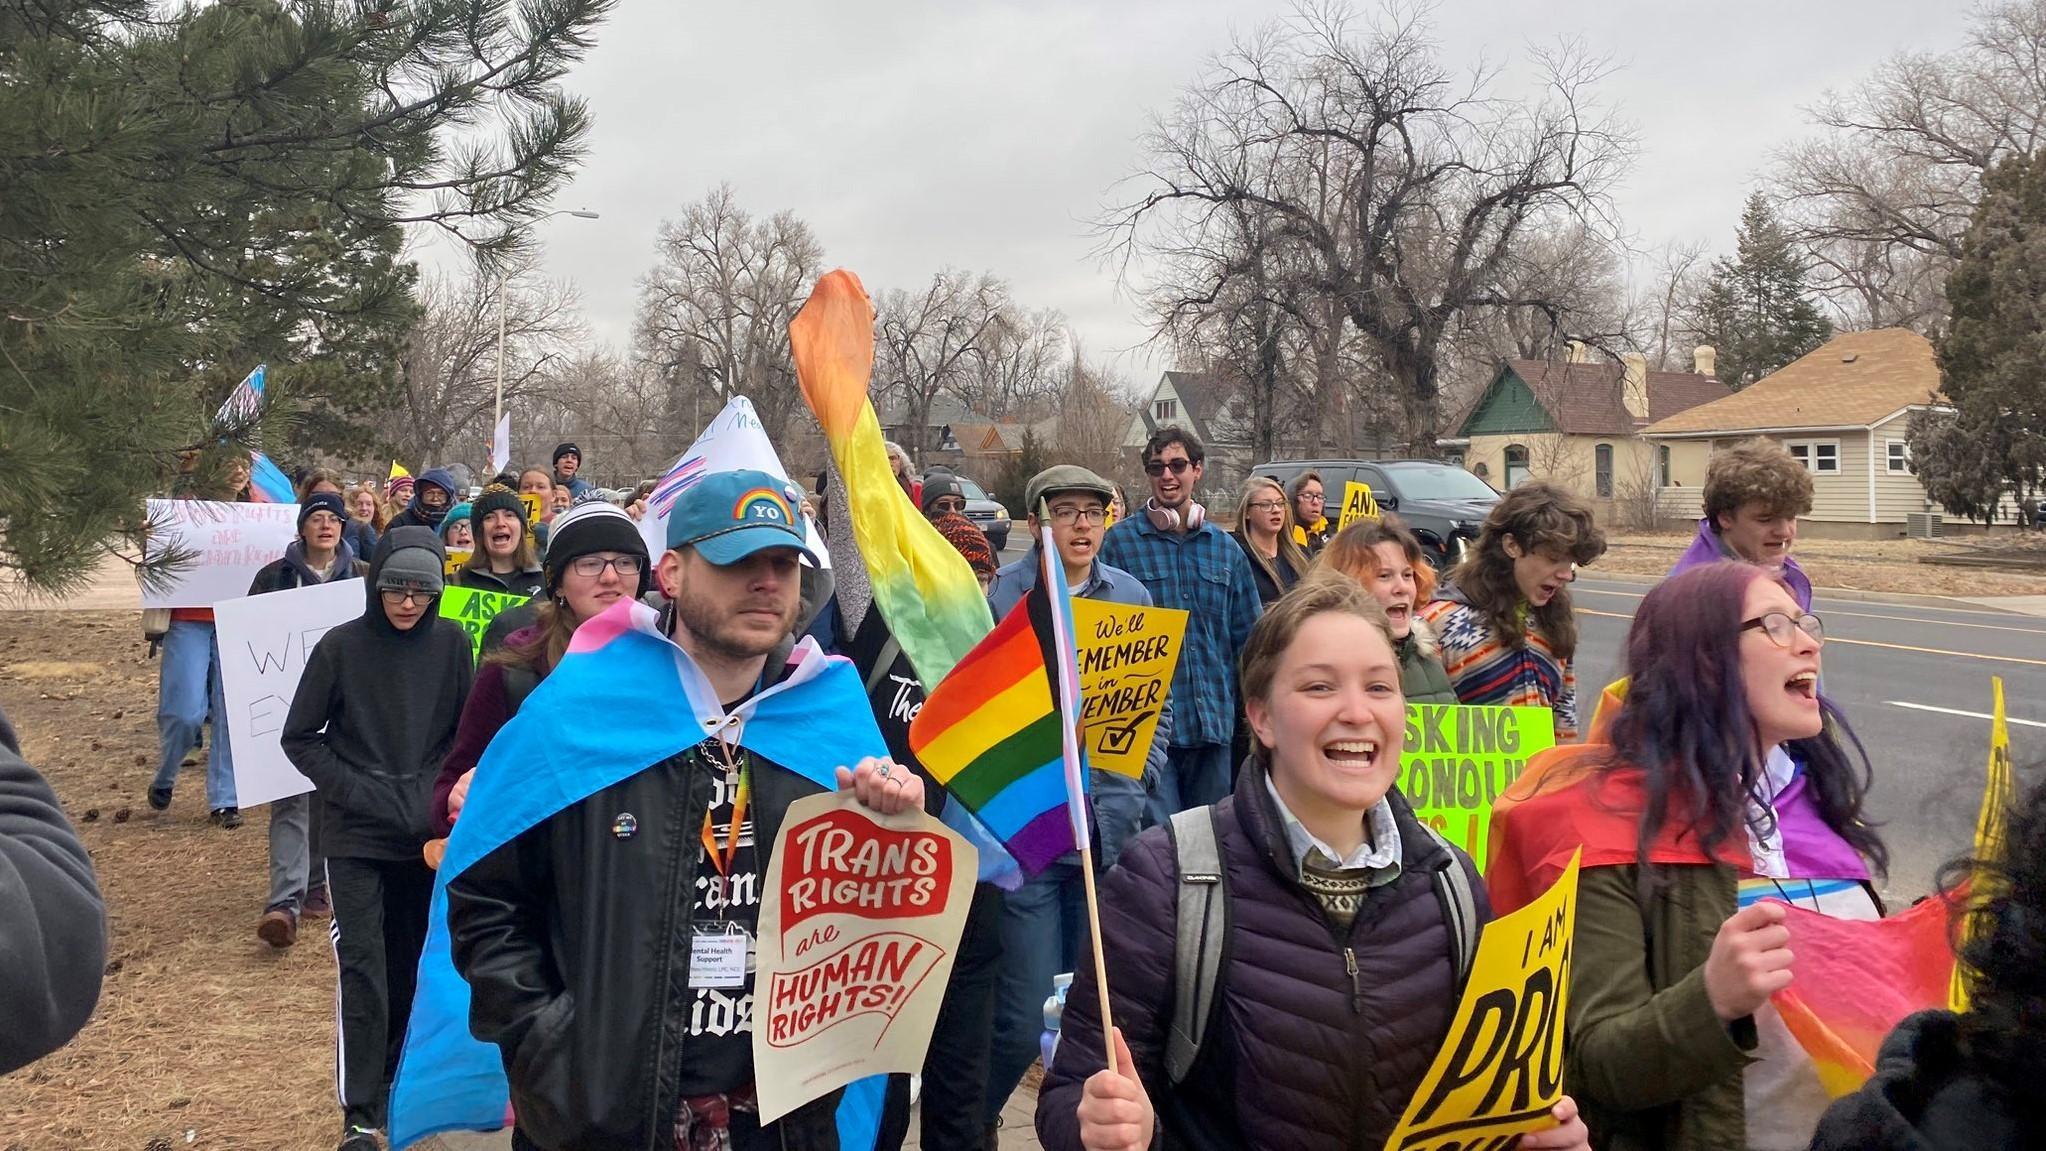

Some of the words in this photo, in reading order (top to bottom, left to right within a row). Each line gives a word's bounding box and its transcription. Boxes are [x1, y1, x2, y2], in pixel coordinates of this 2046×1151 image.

[752, 505, 779, 520] YO
[1095, 612, 1145, 639] We'll
[1098, 676, 1118, 690] in
[250, 694, 292, 737] E
[1402, 705, 1520, 754] SKING
[1399, 758, 1528, 810] ONOU
[796, 821, 938, 878] TRANS
[788, 876, 937, 914] RIGHTS
[796, 924, 840, 957] are
[1521, 930, 1533, 969] I
[1539, 894, 1567, 958] AM
[697, 955, 722, 963] Support
[776, 941, 923, 1009] HUMAN
[686, 989, 753, 1037] ids
[772, 984, 905, 1042] RIGHTS!
